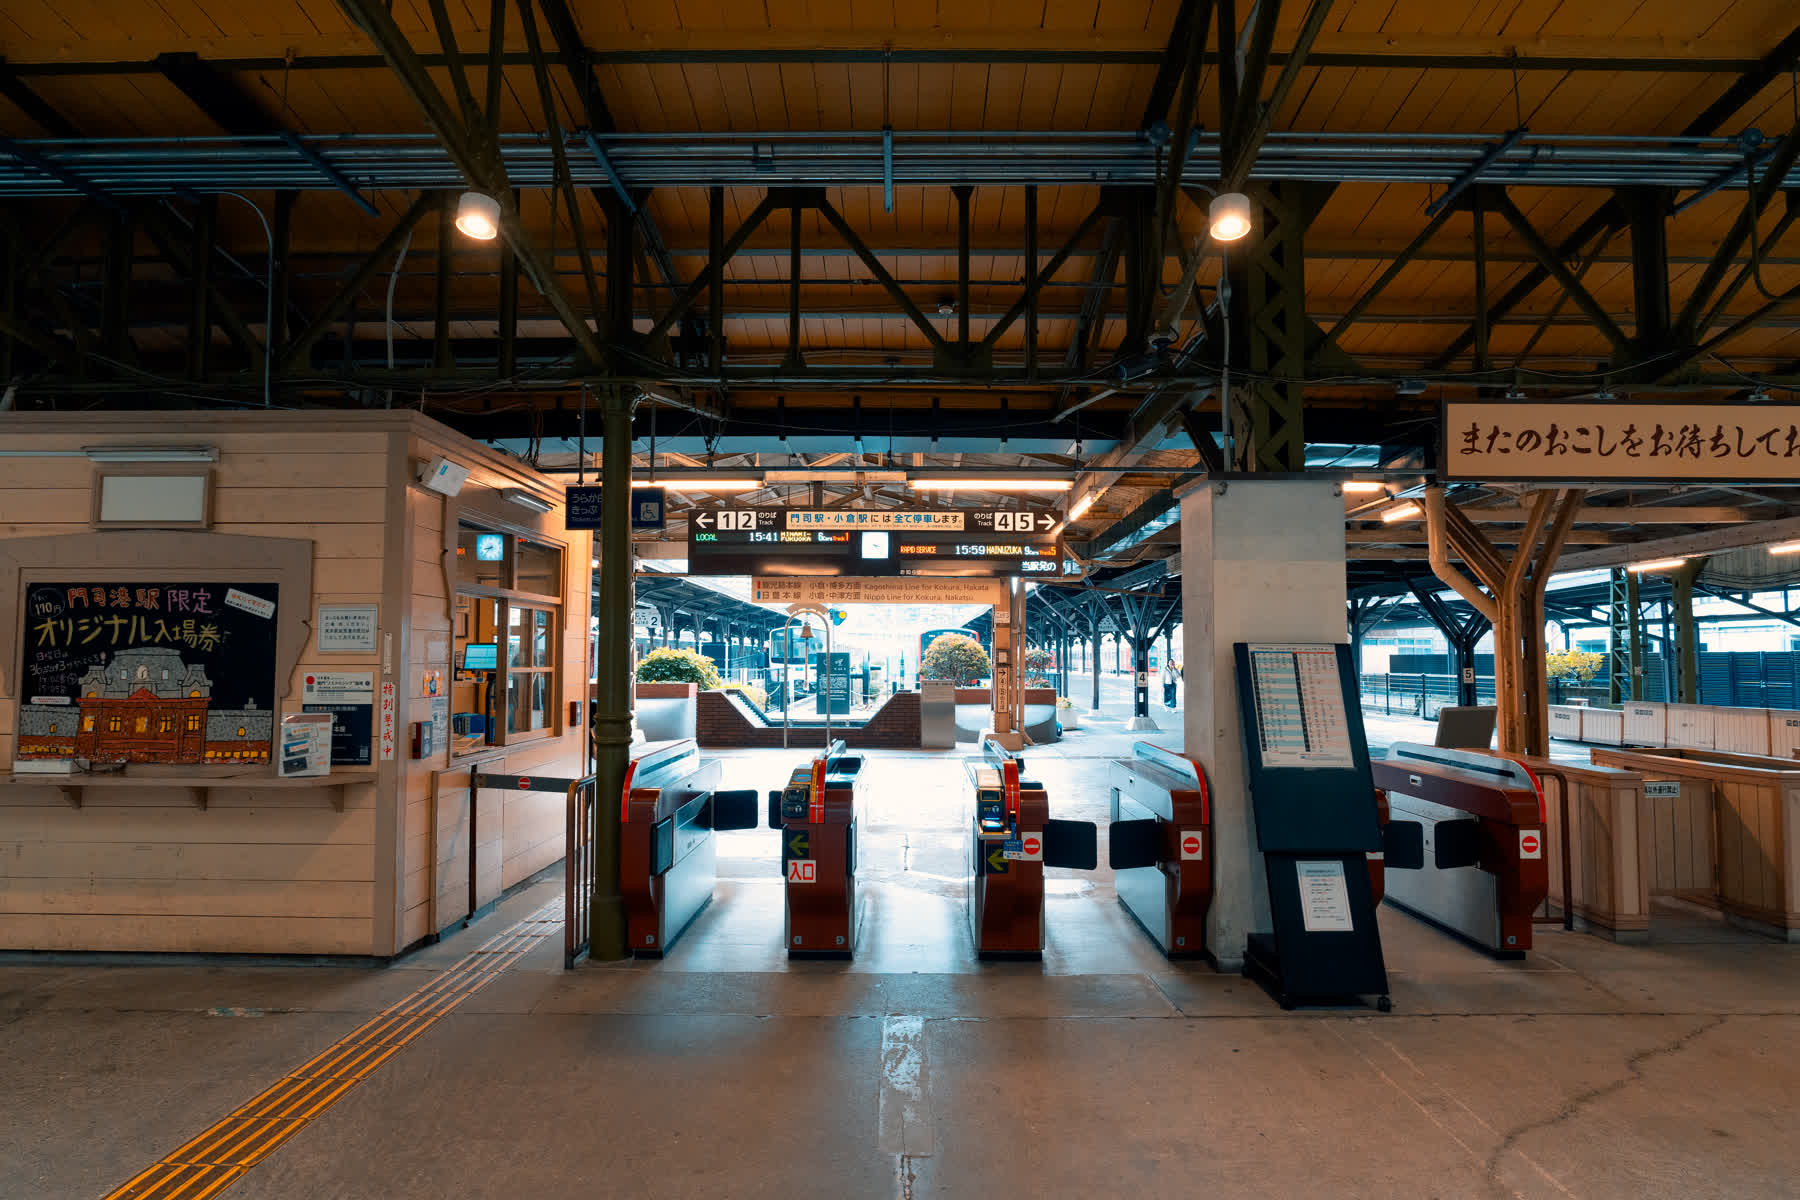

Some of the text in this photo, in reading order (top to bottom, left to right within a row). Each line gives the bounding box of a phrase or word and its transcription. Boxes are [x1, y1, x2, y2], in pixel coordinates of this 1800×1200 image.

[722, 513, 752, 528] 1 2
[789, 513, 963, 524] 門司駅・小倉駅には全て停車します。
[997, 514, 1030, 529] 4 5
[695, 533, 718, 542] LOCAL
[749, 532, 778, 542] 15:41
[900, 545, 915, 554] RAPID
[915, 545, 937, 554] SERVICE
[955, 545, 986, 555] 15:59
[905, 583, 920, 591] Line
[922, 583, 931, 591] for
[964, 583, 989, 591] Hakata
[66, 587, 160, 609] 門司港駅
[167, 587, 213, 613] 限定
[651, 616, 658, 625] 2
[33, 614, 221, 652] オリジナル入場券
[1139, 673, 1146, 682] 4
[1465, 669, 1472, 678] 5
[789, 862, 815, 881] 入口
